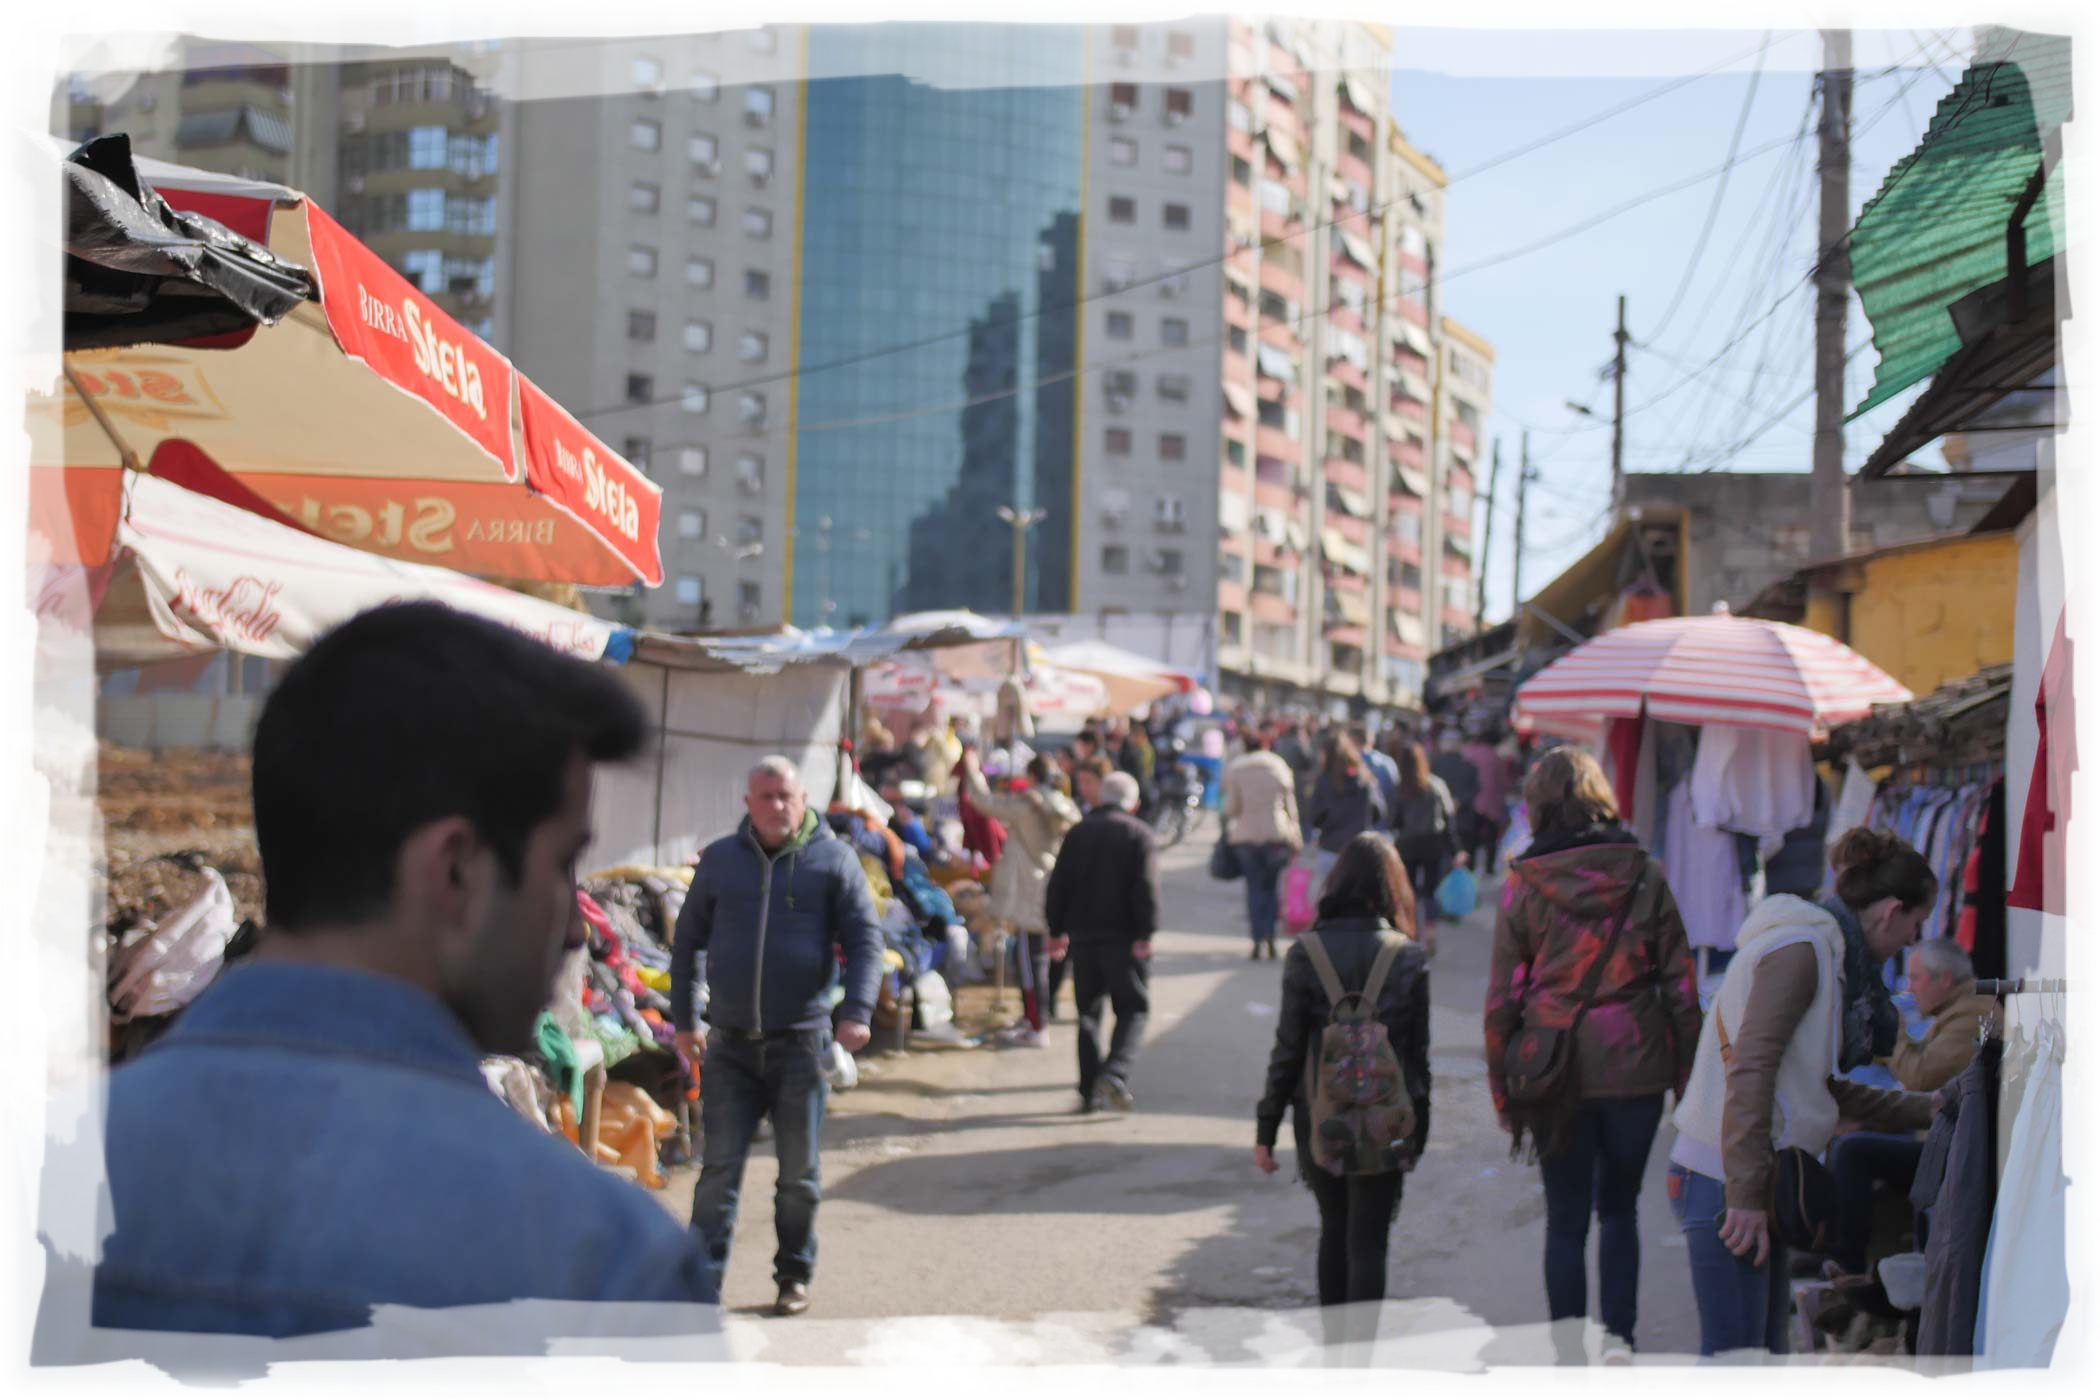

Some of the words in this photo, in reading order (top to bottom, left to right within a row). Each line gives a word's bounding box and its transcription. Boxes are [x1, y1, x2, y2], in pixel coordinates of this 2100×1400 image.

[357, 281, 409, 343] BIRRA
[403, 297, 487, 421] Stela
[582, 447, 640, 543] Stela
